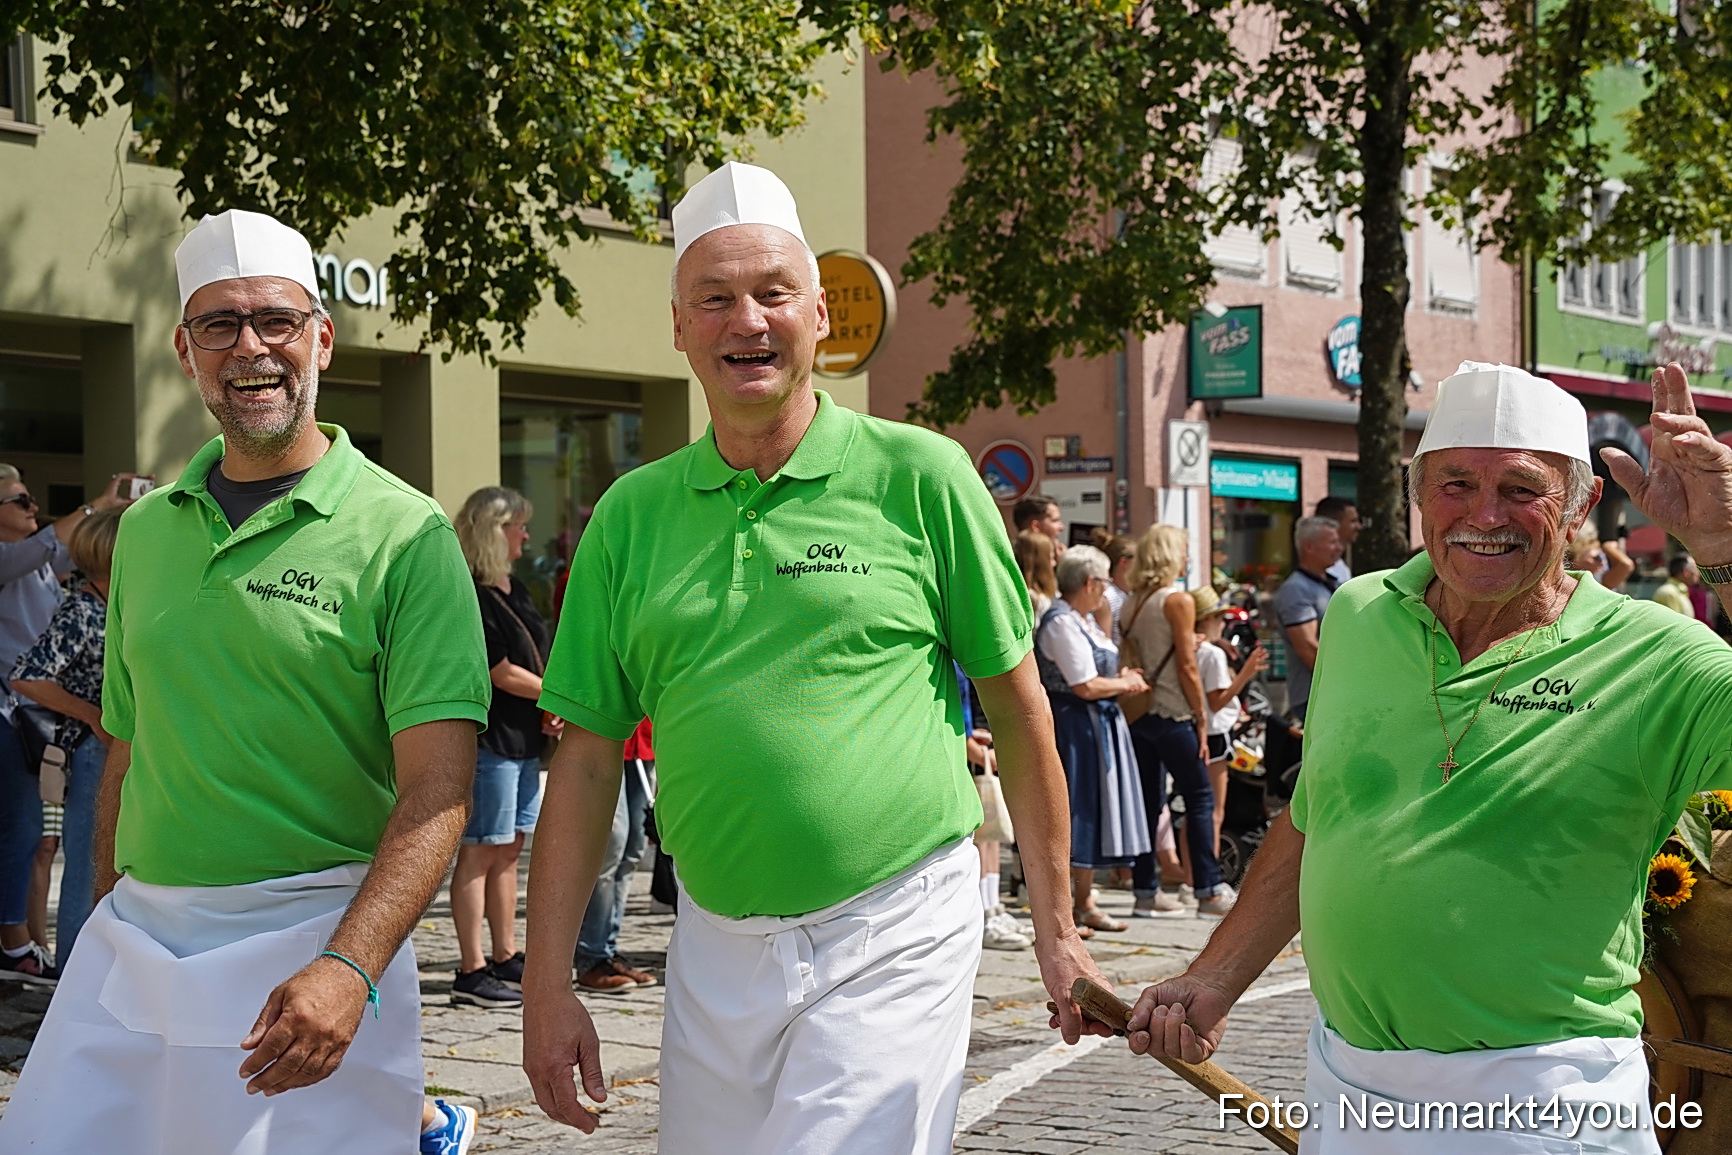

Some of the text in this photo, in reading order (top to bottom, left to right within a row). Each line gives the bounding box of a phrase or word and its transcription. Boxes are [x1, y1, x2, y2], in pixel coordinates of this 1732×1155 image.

[826, 286, 874, 304] OTEL
[828, 323, 874, 340] ARKT
[1208, 326, 1250, 355] FASS
[1336, 343, 1362, 380] FA
[806, 543, 847, 559] OGV
[776, 560, 873, 579] Woffenbach e.V.
[281, 569, 324, 592] OGV
[245, 578, 345, 616] Woffenbach e.V.
[1532, 677, 1580, 696] OGV
[1489, 690, 1575, 715] Woffenbach
